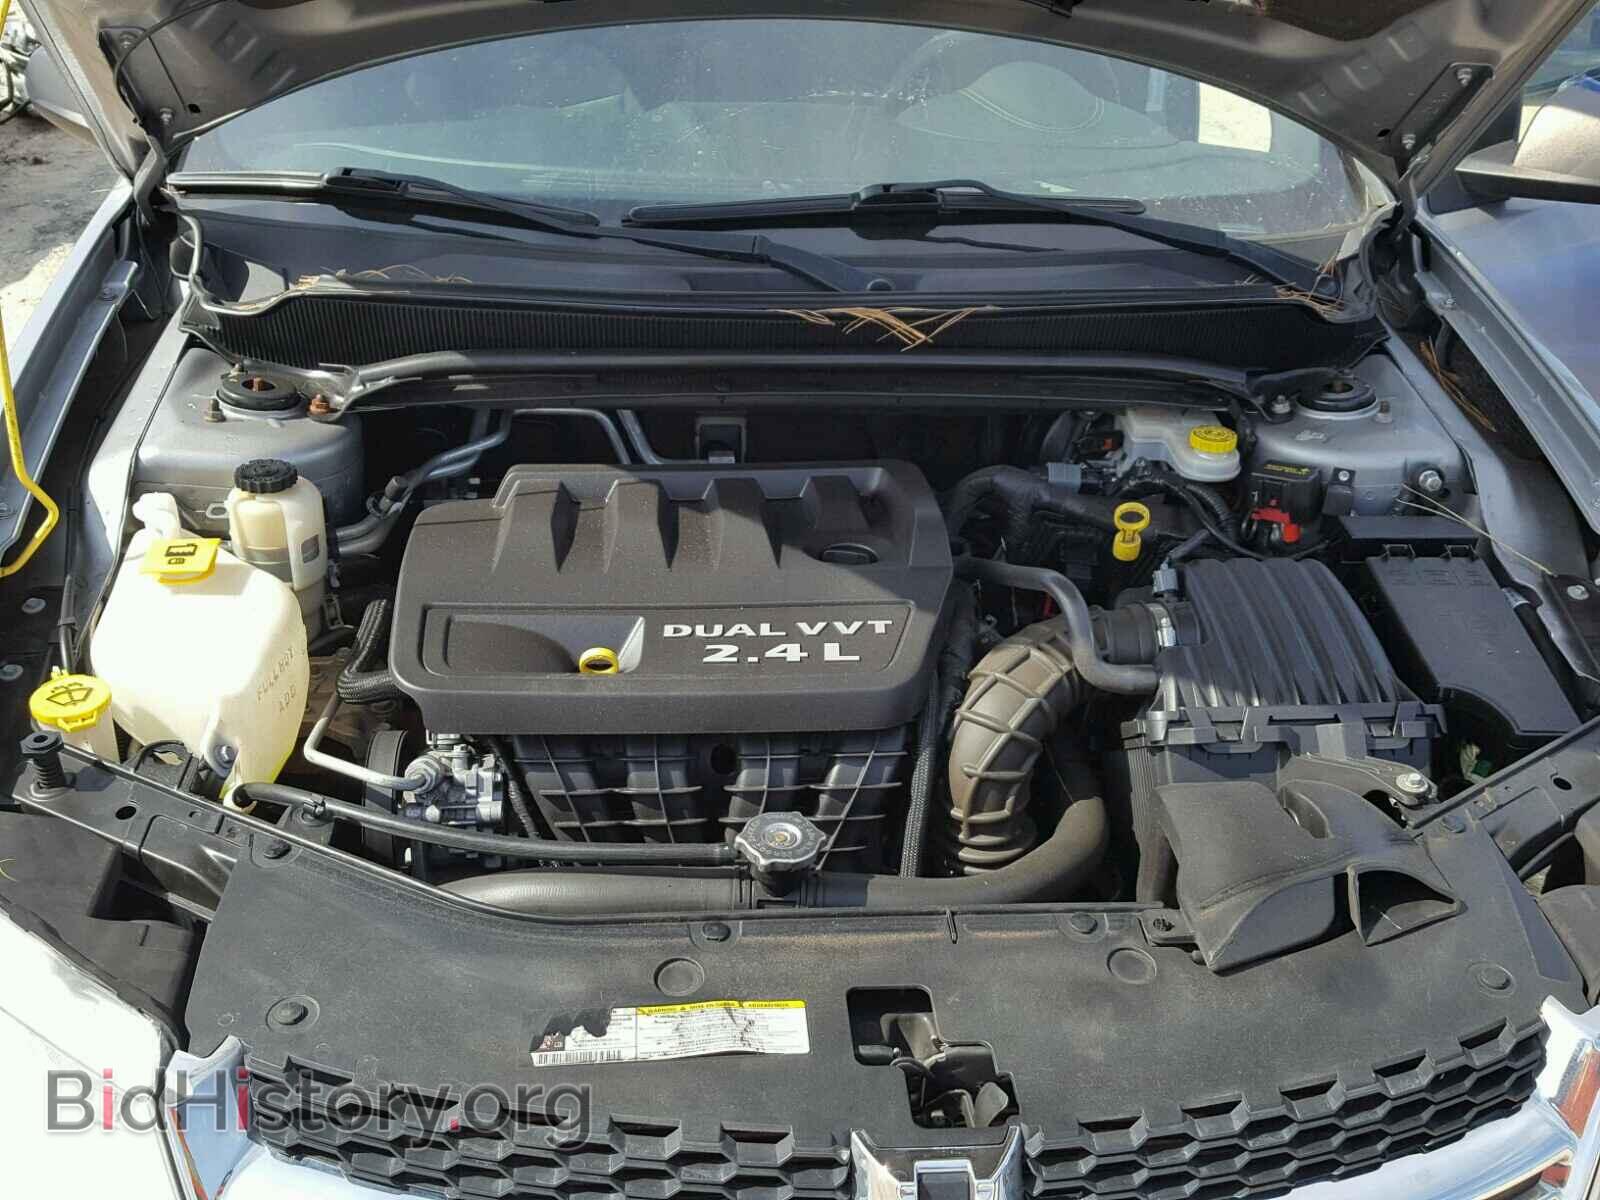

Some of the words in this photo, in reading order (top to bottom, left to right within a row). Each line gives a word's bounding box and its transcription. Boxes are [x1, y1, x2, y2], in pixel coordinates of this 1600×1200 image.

[662, 623, 787, 638] DUAL
[795, 620, 893, 636] VVT
[702, 643, 809, 663] 2.4
[823, 642, 861, 662] L
